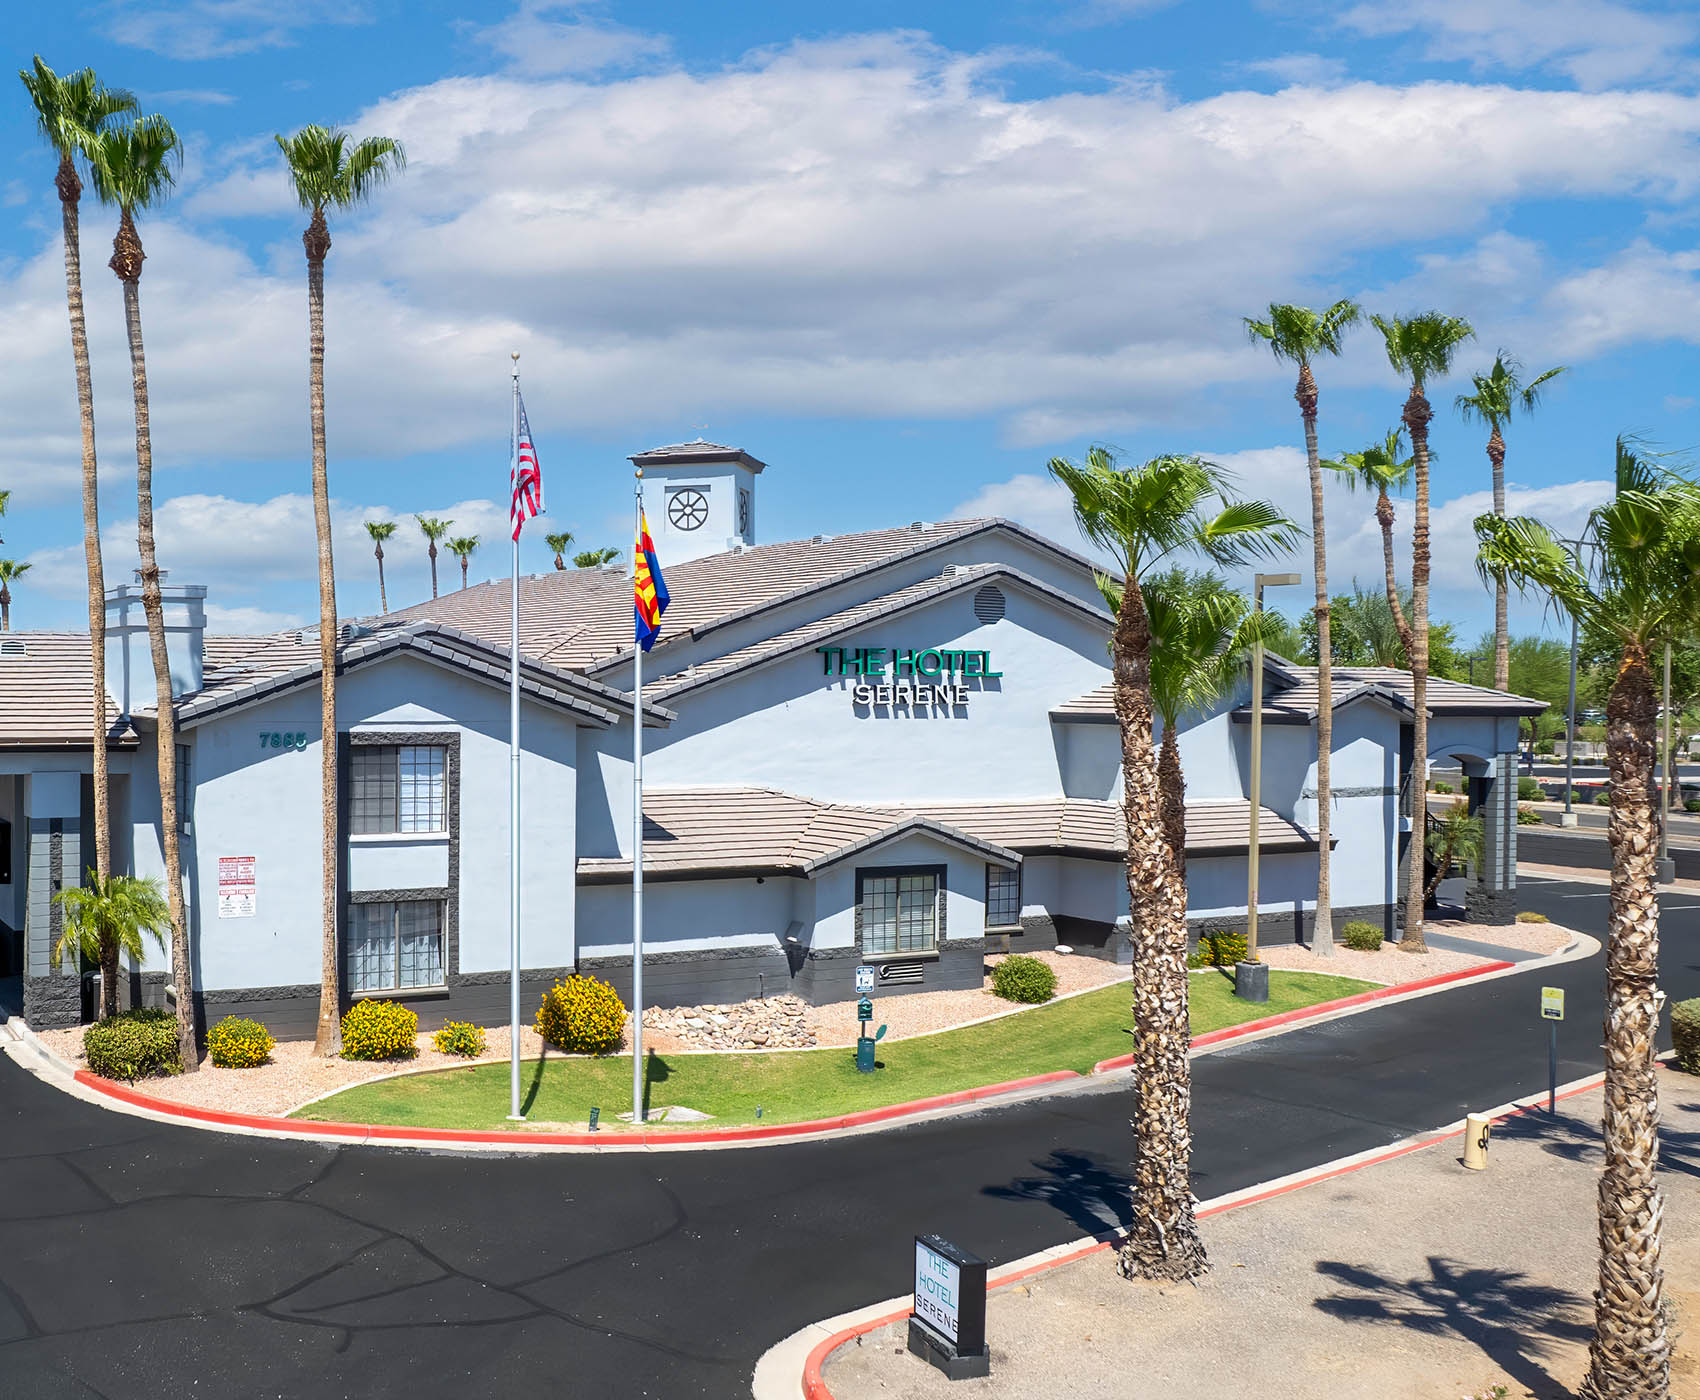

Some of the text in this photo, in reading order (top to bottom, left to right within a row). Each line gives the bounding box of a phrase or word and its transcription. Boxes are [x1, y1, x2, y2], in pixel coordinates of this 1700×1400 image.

[817, 647, 1003, 678] THE HOTEL
[854, 684, 970, 705] SERENE
[926, 1249, 949, 1279] THE
[919, 1271, 956, 1309] HOTEL
[916, 1294, 959, 1334] SERENE
